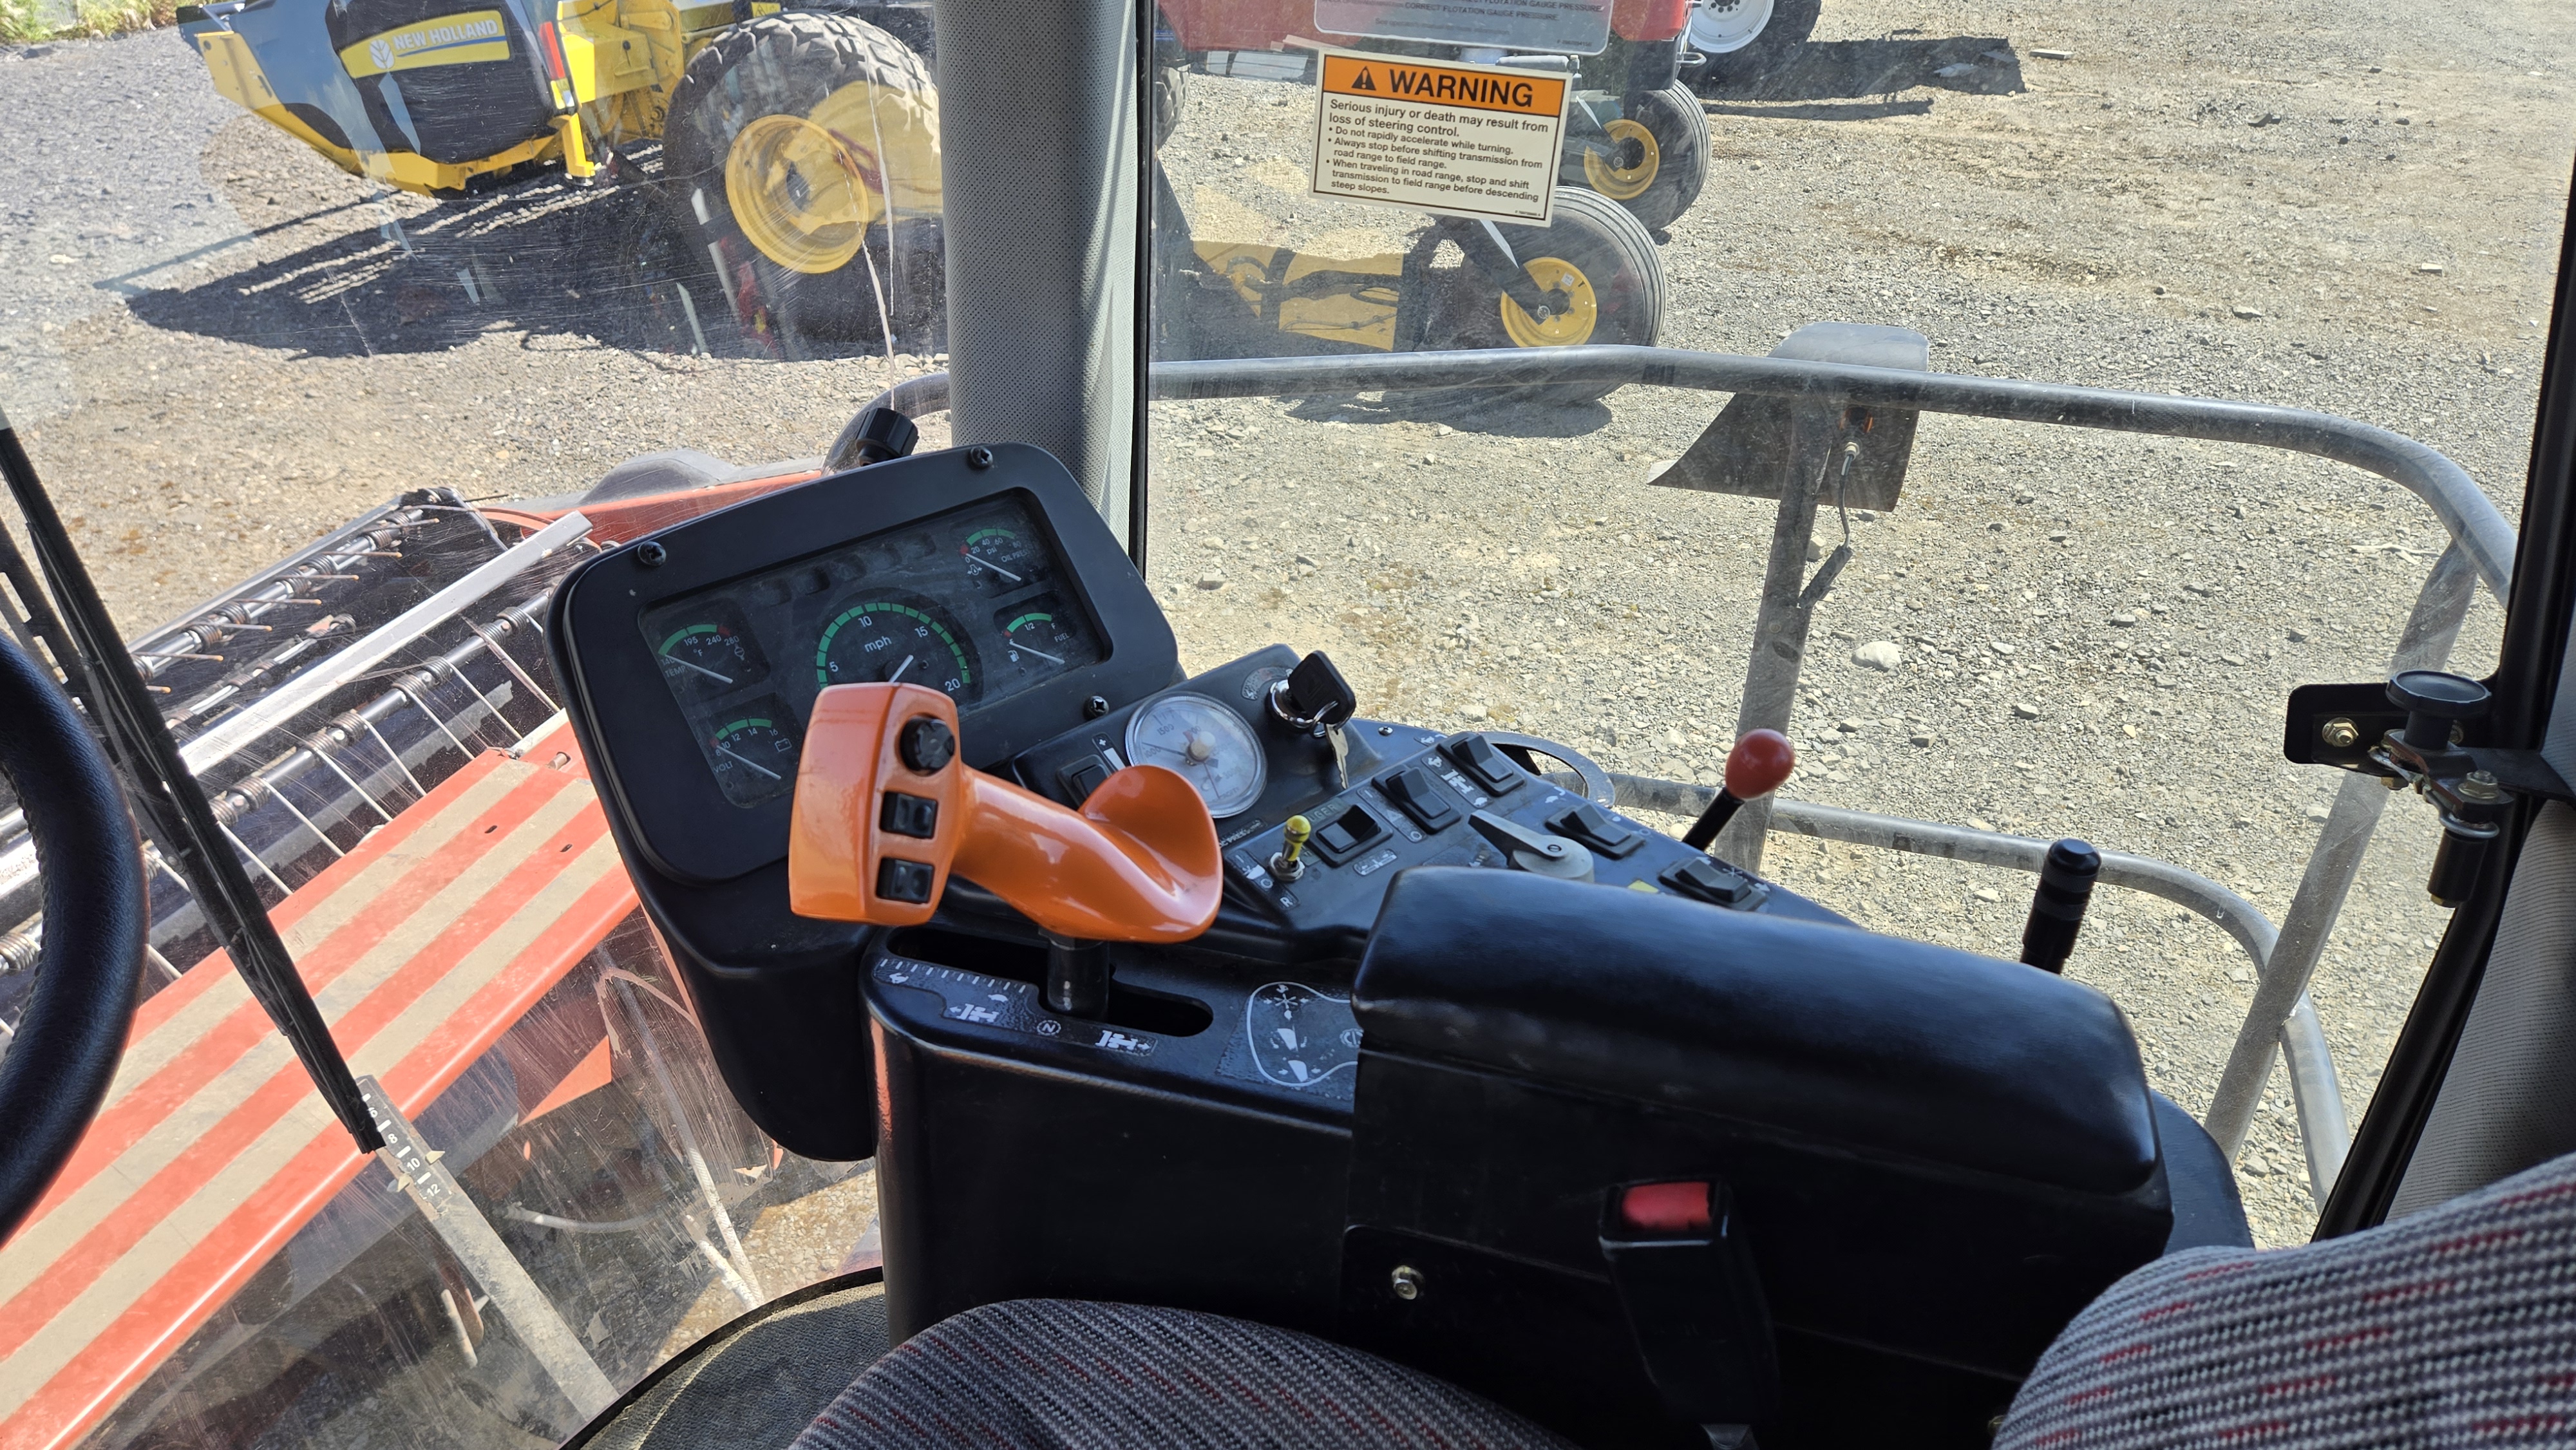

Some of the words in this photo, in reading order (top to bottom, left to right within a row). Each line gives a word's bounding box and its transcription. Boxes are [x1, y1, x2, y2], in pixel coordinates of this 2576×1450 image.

[1443, 6, 1485, 15] FLOTATION
[393, 32, 427, 50] NEW
[429, 19, 498, 45] HOLLAND
[1389, 68, 1533, 108] WARNING
[1330, 99, 1372, 113] Serious
[1375, 104, 1406, 118] injury
[1408, 110, 1421, 118] or
[1424, 109, 1455, 122] death
[1459, 115, 1483, 127] may
[1486, 118, 1519, 129] result
[1522, 120, 1548, 133] from
[1329, 113, 1351, 124] loss
[1354, 117, 1366, 126] of
[1368, 119, 1414, 133] steering
[1417, 124, 1459, 137] control.
[1336, 126, 1348, 135] Do
[1350, 129, 1365, 137] not
[1367, 131, 1398, 142] rapidly
[1401, 135, 1448, 147] accelerate
[1451, 140, 1475, 150] while
[1478, 143, 1513, 155] turning.
[1334, 137, 1366, 149] Always
[1368, 142, 1388, 152] stop
[1391, 144, 1420, 155] before
[1423, 147, 1456, 160] shifting
[1459, 152, 1519, 166] transmission
[1521, 159, 1542, 169] from
[1334, 149, 1354, 158] road
[1356, 152, 1382, 162] range
[1385, 154, 1394, 162] to
[1396, 155, 1416, 165] field
[1418, 159, 1446, 169] range.
[1332, 158, 1358, 169] When
[1360, 162, 1399, 175] traveling
[1401, 166, 1409, 174] in
[1412, 169, 1432, 178] road
[1435, 171, 1463, 183] range,
[1466, 175, 1487, 185] stop
[1489, 178, 1507, 187] and
[1509, 180, 1530, 189] shift
[1331, 180, 1356, 191] steep
[1358, 184, 1390, 194] slopes.
[1332, 170, 1389, 183] transmission
[1392, 176, 1401, 185] to
[1403, 178, 1423, 187] field
[1425, 182, 1451, 192] range
[1454, 184, 1483, 194] before
[1485, 188, 1539, 203] descending
[987, 546, 998, 555] psi
[858, 616, 873, 628] 10
[1025, 622, 1035, 631] 1/2
[914, 626, 929, 638] 15
[1054, 632, 1070, 643] FUEL
[683, 636, 699, 646] 195
[706, 634, 722, 645] 240
[724, 636, 740, 646] 280
[864, 636, 893, 652] mph
[665, 665, 687, 678] TEMP
[829, 661, 839, 672] 5
[944, 678, 961, 692] 20
[748, 728, 758, 736] 14
[1157, 723, 1175, 736] 1500
[731, 733, 741, 742] 12
[713, 760, 734, 773] VOLT
[1308, 804, 1340, 822] UGER
[1042, 1022, 1056, 1033] N
[388, 1133, 398, 1144] 8
[407, 1158, 421, 1171] 10
[427, 1183, 440, 1197] 12
